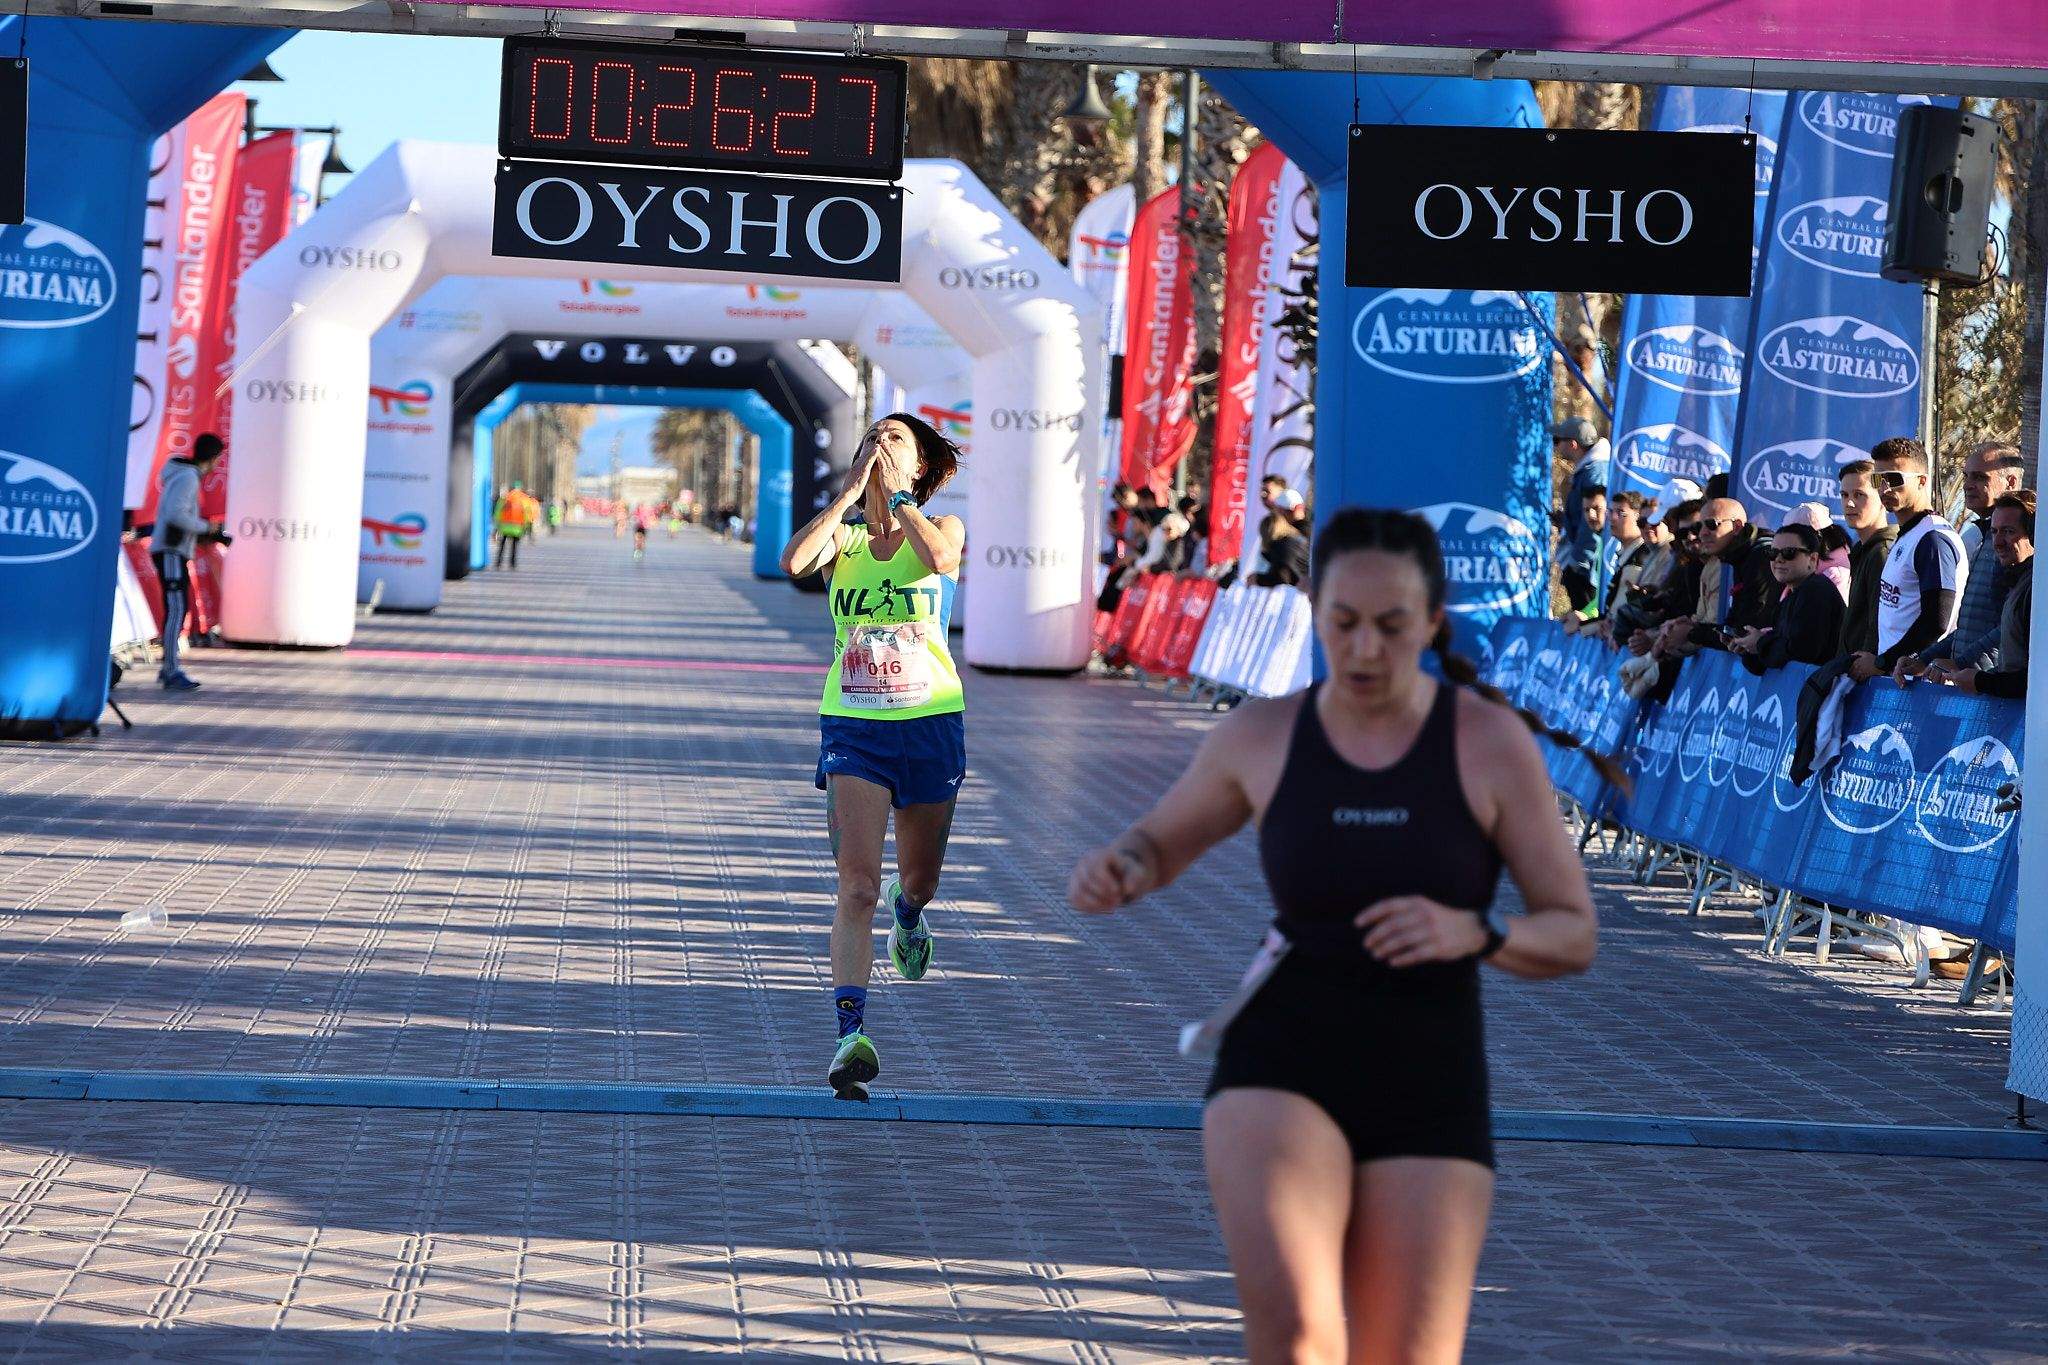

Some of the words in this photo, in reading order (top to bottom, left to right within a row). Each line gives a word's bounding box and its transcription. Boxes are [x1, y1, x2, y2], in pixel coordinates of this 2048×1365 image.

[530, 57, 878, 156] 00:26:27
[515, 176, 883, 265] OYSHO
[1414, 183, 1694, 246] OYSHO
[171, 143, 217, 329] Santander
[299, 245, 402, 273] OYSHO
[939, 267, 1040, 291] OYSHO
[533, 339, 738, 368] VOLVO
[1799, 338, 1851, 352] CENTRAL
[1769, 336, 1910, 385] ASTURIANA
[238, 517, 336, 544] OYSH
[985, 545, 1067, 570] OYSH
[867, 660, 902, 677] 016
[849, 695, 877, 704] OYSHO
[1825, 765, 1903, 811] ASTURIANA
